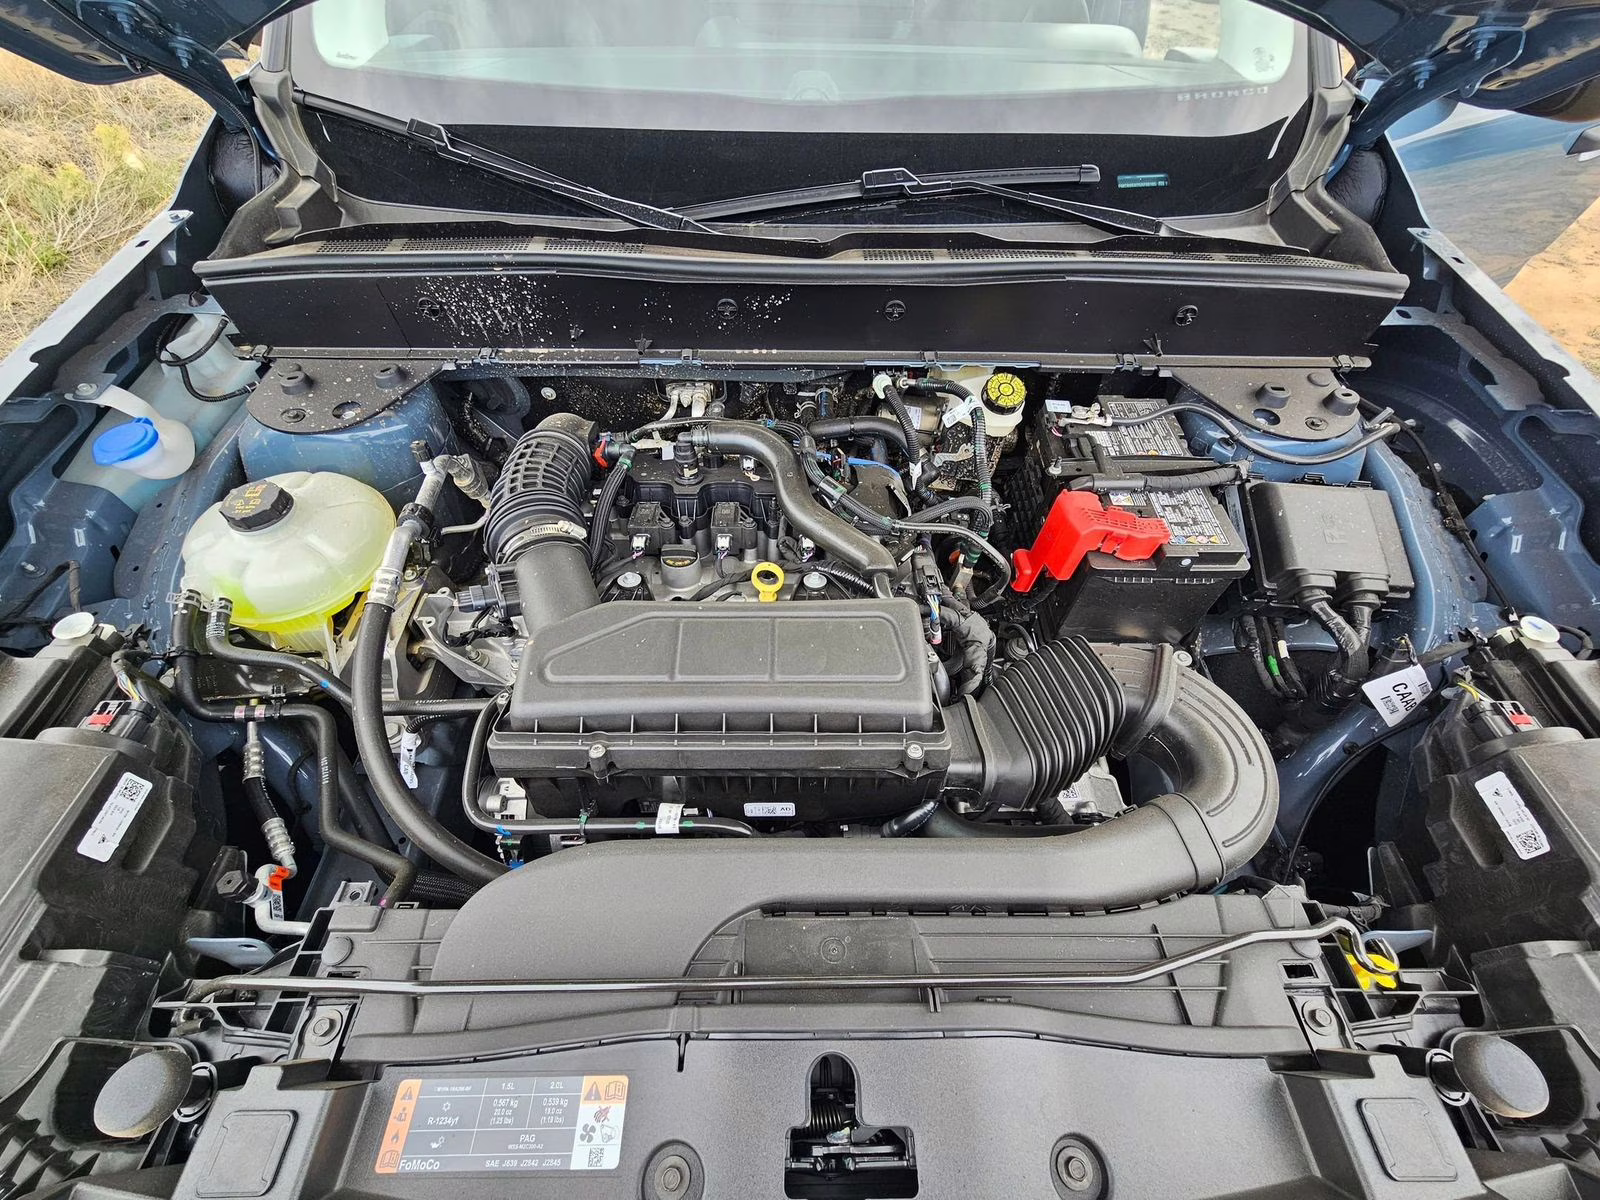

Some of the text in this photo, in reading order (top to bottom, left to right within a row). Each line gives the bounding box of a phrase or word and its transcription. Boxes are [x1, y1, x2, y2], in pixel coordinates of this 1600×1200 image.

[1392, 682, 1417, 711] CAAB
[510, 1098, 518, 1108] kg
[560, 1097, 569, 1108] kg
[427, 1116, 460, 1127] R-1234yf
[519, 1133, 536, 1143] PAG
[398, 1158, 440, 1170] FoMoCo
[485, 1159, 500, 1168] SAE
[502, 1159, 518, 1168] J639
